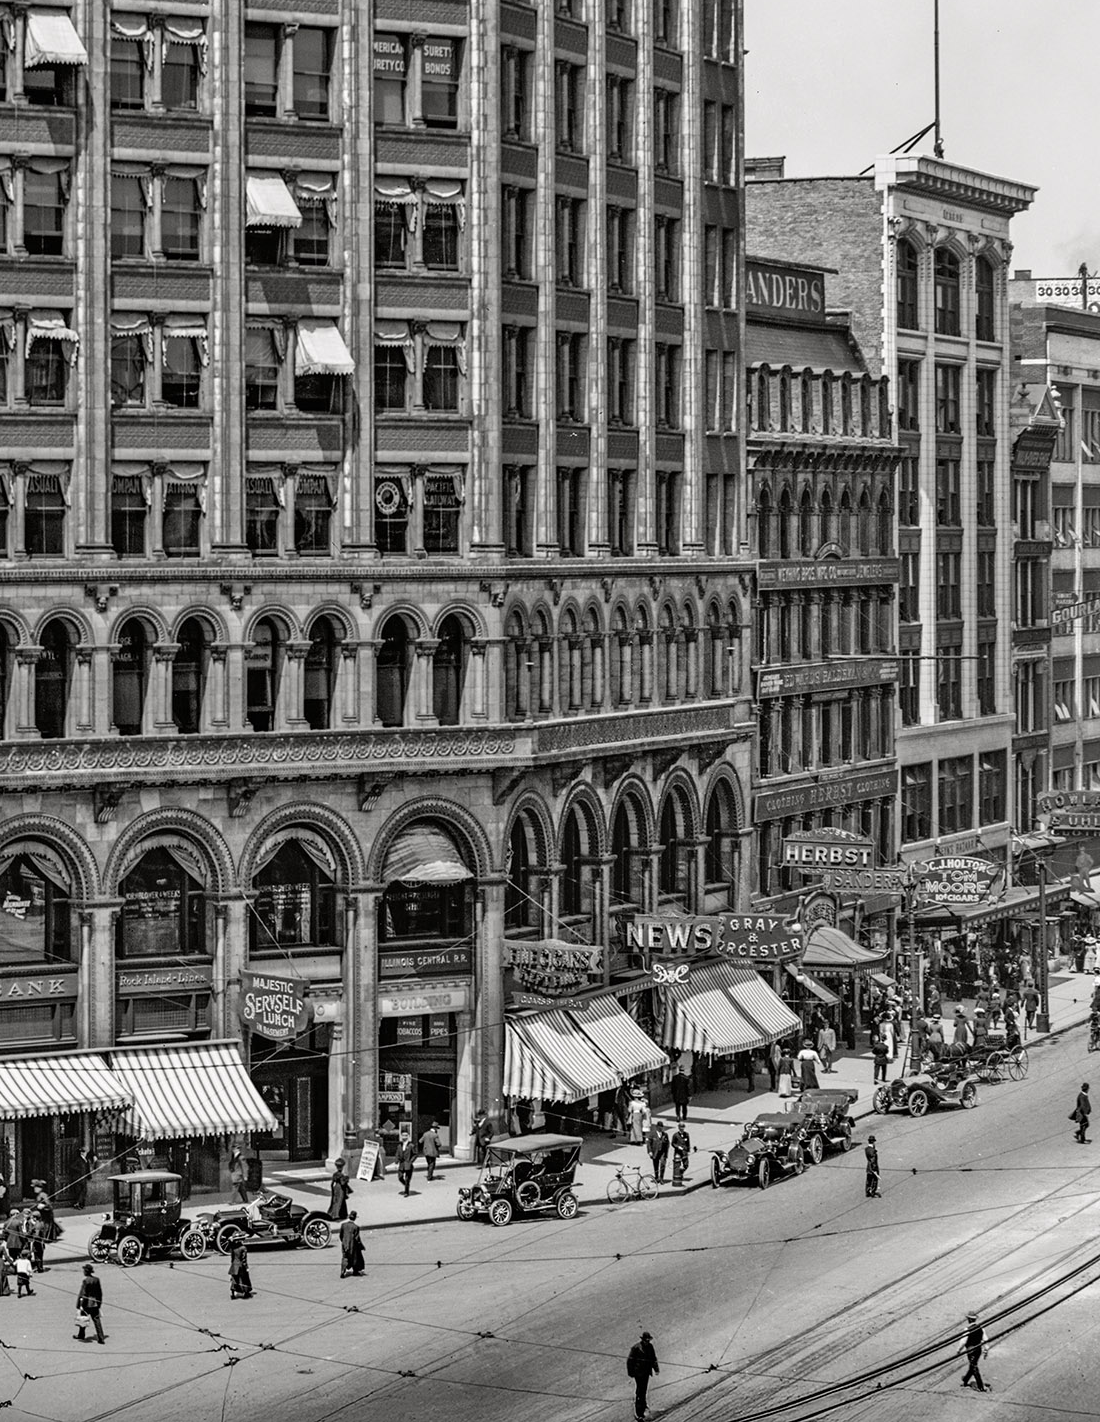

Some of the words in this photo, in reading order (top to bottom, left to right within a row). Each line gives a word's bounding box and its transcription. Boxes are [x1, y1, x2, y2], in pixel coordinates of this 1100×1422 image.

[423, 44, 454, 58] SURETY
[425, 62, 451, 75] BONDS
[1038, 286, 1053, 297] 30
[1054, 286, 1070, 297] 30
[810, 782, 853, 804] HERBST
[786, 845, 872, 865] HERBST
[938, 870, 978, 882] TOM
[947, 893, 980, 902] CIGARS
[729, 918, 778, 932] GRAY
[626, 921, 713, 950] NEWS
[748, 933, 759, 943] &
[381, 957, 414, 968] ILLINOIS
[417, 955, 451, 966] CENTRAL
[453, 954, 467, 963] R.R.
[120, 973, 142, 987] Rock
[252, 977, 294, 994] MAJESTIC
[263, 1011, 295, 1029] LUNCH
[263, 1026, 289, 1037] BASEMENT
[430, 1027, 449, 1036] PIPES
